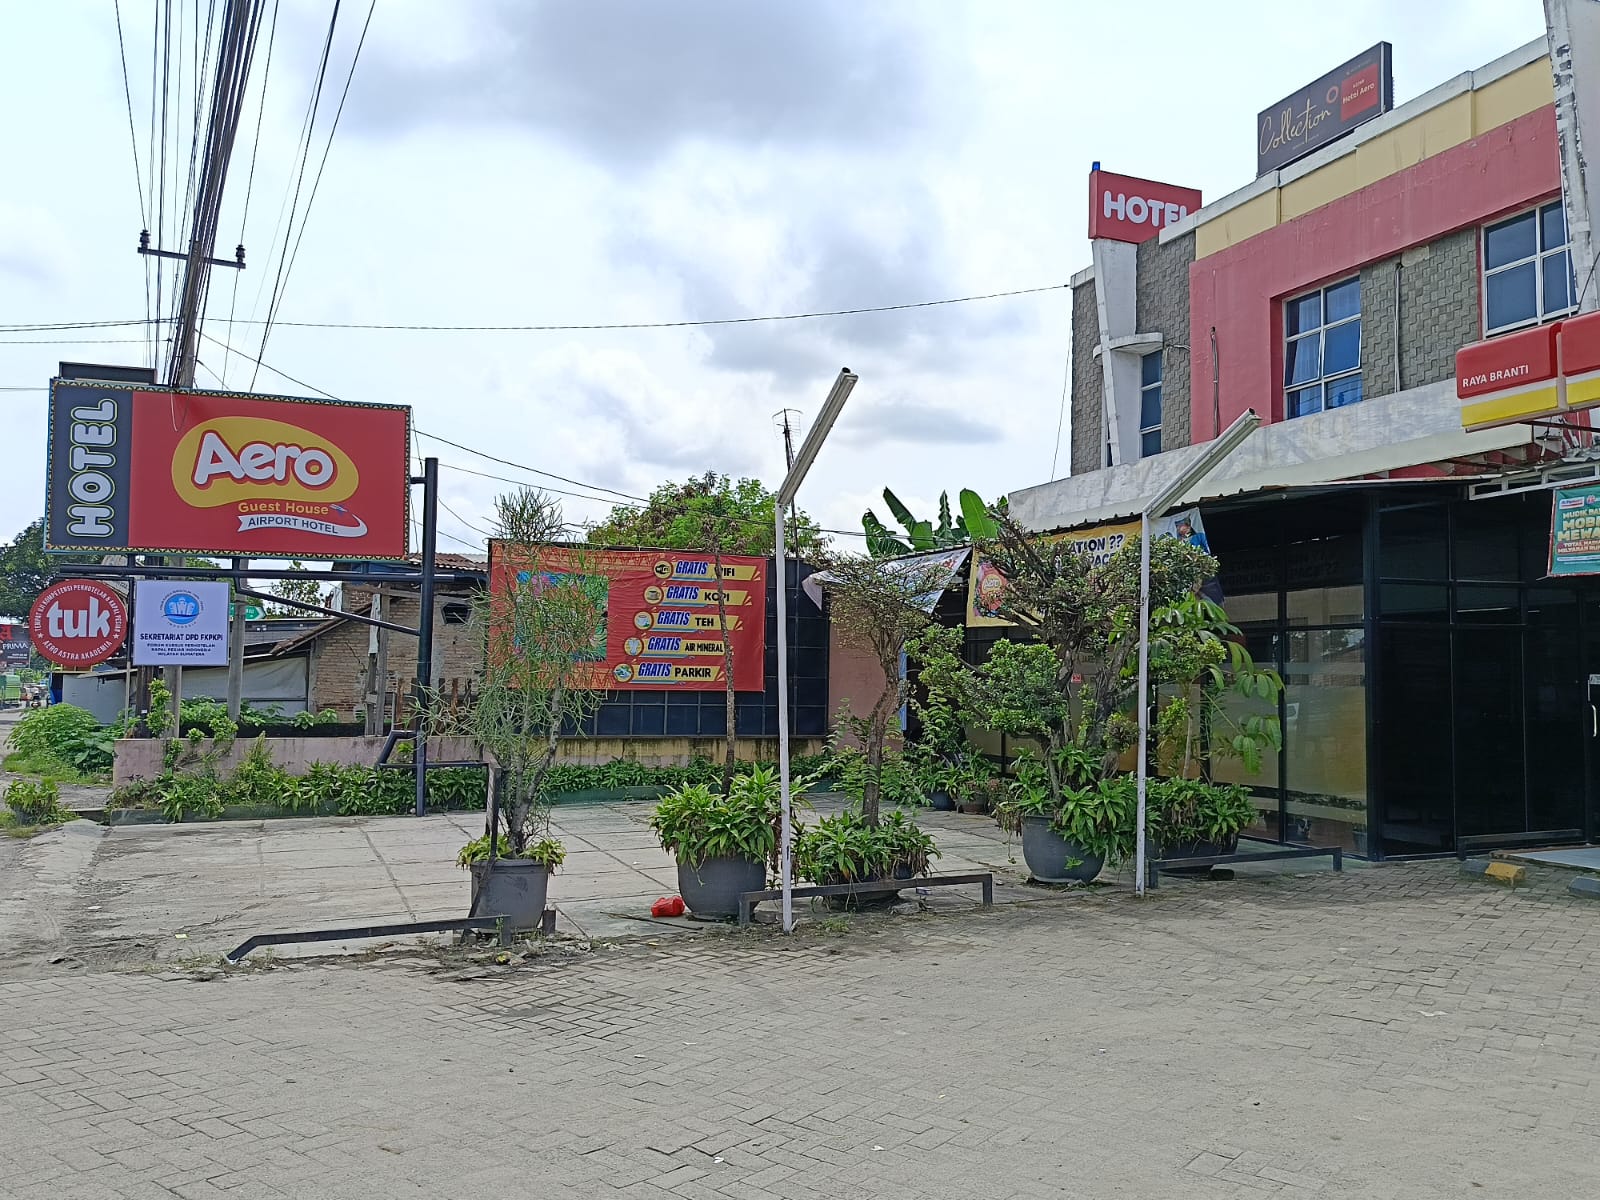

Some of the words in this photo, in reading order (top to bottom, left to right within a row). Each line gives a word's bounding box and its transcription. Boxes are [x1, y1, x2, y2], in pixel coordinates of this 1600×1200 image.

[1342, 90, 1359, 104] Hotel
[1360, 82, 1375, 95] Aero
[1260, 98, 1331, 155] Collection
[1462, 374, 1487, 388] RAYA
[1489, 364, 1529, 382] BRANTI
[193, 432, 334, 486] Aero
[67, 399, 117, 537] HOTEL
[238, 502, 281, 513] Guest
[286, 502, 329, 515] House
[248, 515, 298, 528] AIRPORT
[301, 519, 338, 534] HOTEL
[1109, 534, 1124, 549] ??
[676, 560, 709, 575] GRATIS
[666, 585, 699, 600] GRATIS
[46, 596, 111, 638] tuk
[657, 611, 690, 626] GRATIS
[695, 617, 714, 627] TEH
[140, 633, 185, 641] SEKRETARIAT
[186, 633, 199, 641] DPD
[200, 633, 223, 641] FKPKPI
[647, 637, 682, 651] GRATIS
[685, 643, 696, 652] AIR
[696, 643, 724, 653] MINERAL
[42, 640, 59, 654] AERO
[58, 650, 80, 660] ASTRA
[80, 640, 113, 660] AKADEMIA
[638, 663, 672, 677] GRATIS
[674, 667, 711, 678] PARKIR
